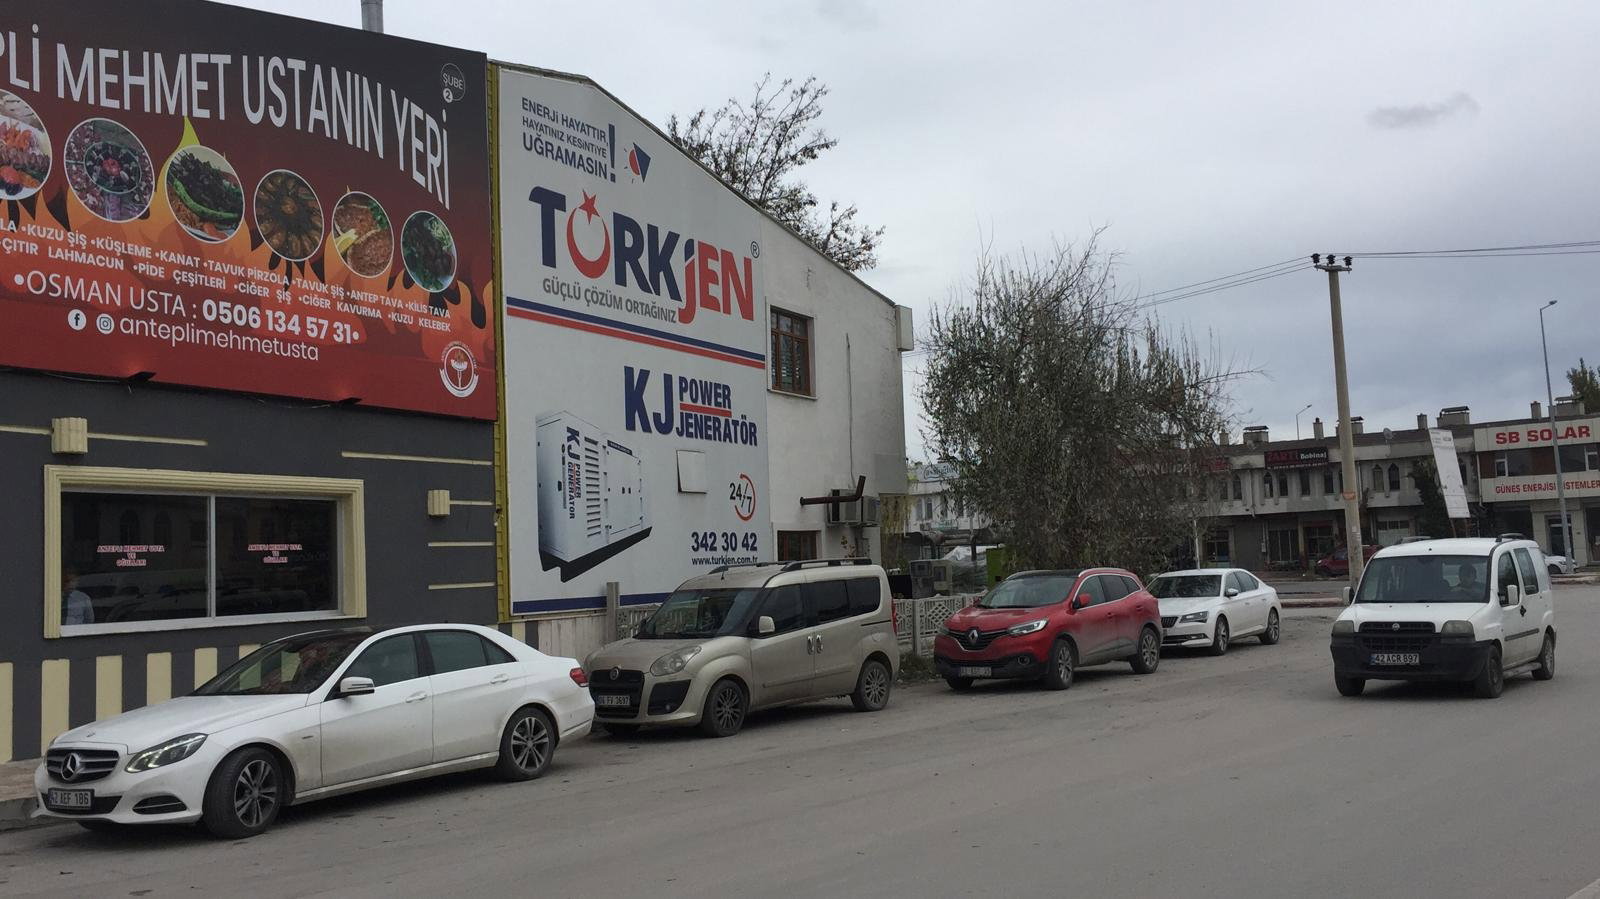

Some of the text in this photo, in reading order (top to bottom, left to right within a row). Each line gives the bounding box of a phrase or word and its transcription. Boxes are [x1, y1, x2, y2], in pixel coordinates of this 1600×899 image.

[442, 72, 464, 90] ŞUBE
[0, 23, 450, 210] Lİ MEHMET USTANIN YERİ
[522, 115, 565, 142] HAYATINIZ
[561, 113, 609, 147] HAYATTIR,
[2, 237, 451, 333] ÇITIR LAHMACUN PİDE ÇEŞİTLERİ CİĞER ŞİŞ CİĞER KAVURMA KUZU KELEBEK
[27, 223, 64, 241] KUZU
[67, 230, 87, 249] ŞİŞ
[95, 236, 152, 259] KÜŞLEME
[160, 250, 201, 268] KANAT
[207, 260, 245, 277] TAVUK
[247, 267, 290, 286] PİRZOLA
[296, 277, 328, 294] TAVUK
[331, 284, 344, 300] ŞİŞ
[350, 289, 379, 304] ANTEP
[380, 296, 403, 309] TAVA
[429, 305, 451, 319] TAVA
[27, 270, 121, 306] OSMAN
[130, 287, 186, 318] USTA
[202, 298, 261, 329] 0506
[265, 309, 301, 336] 134
[306, 316, 329, 340] 57
[333, 321, 352, 344] 31
[542, 275, 677, 324] GÜÇLÜ ÇÖZÜM ORTAĞINIZ
[119, 316, 319, 361] anteplimehmetusta
[623, 365, 732, 435] KJ POWER
[566, 426, 581, 460] KJ
[675, 411, 758, 447] JENERATÖR
[1495, 425, 1591, 445] SB SOLAR
[567, 461, 576, 520] GENERATOR
[729, 482, 752, 513] 24/7
[691, 531, 758, 552] 342 30 42
[691, 555, 759, 566] www.turkjen.com.tr
[1375, 654, 1385, 664] 42
[1386, 654, 1402, 664] ACR
